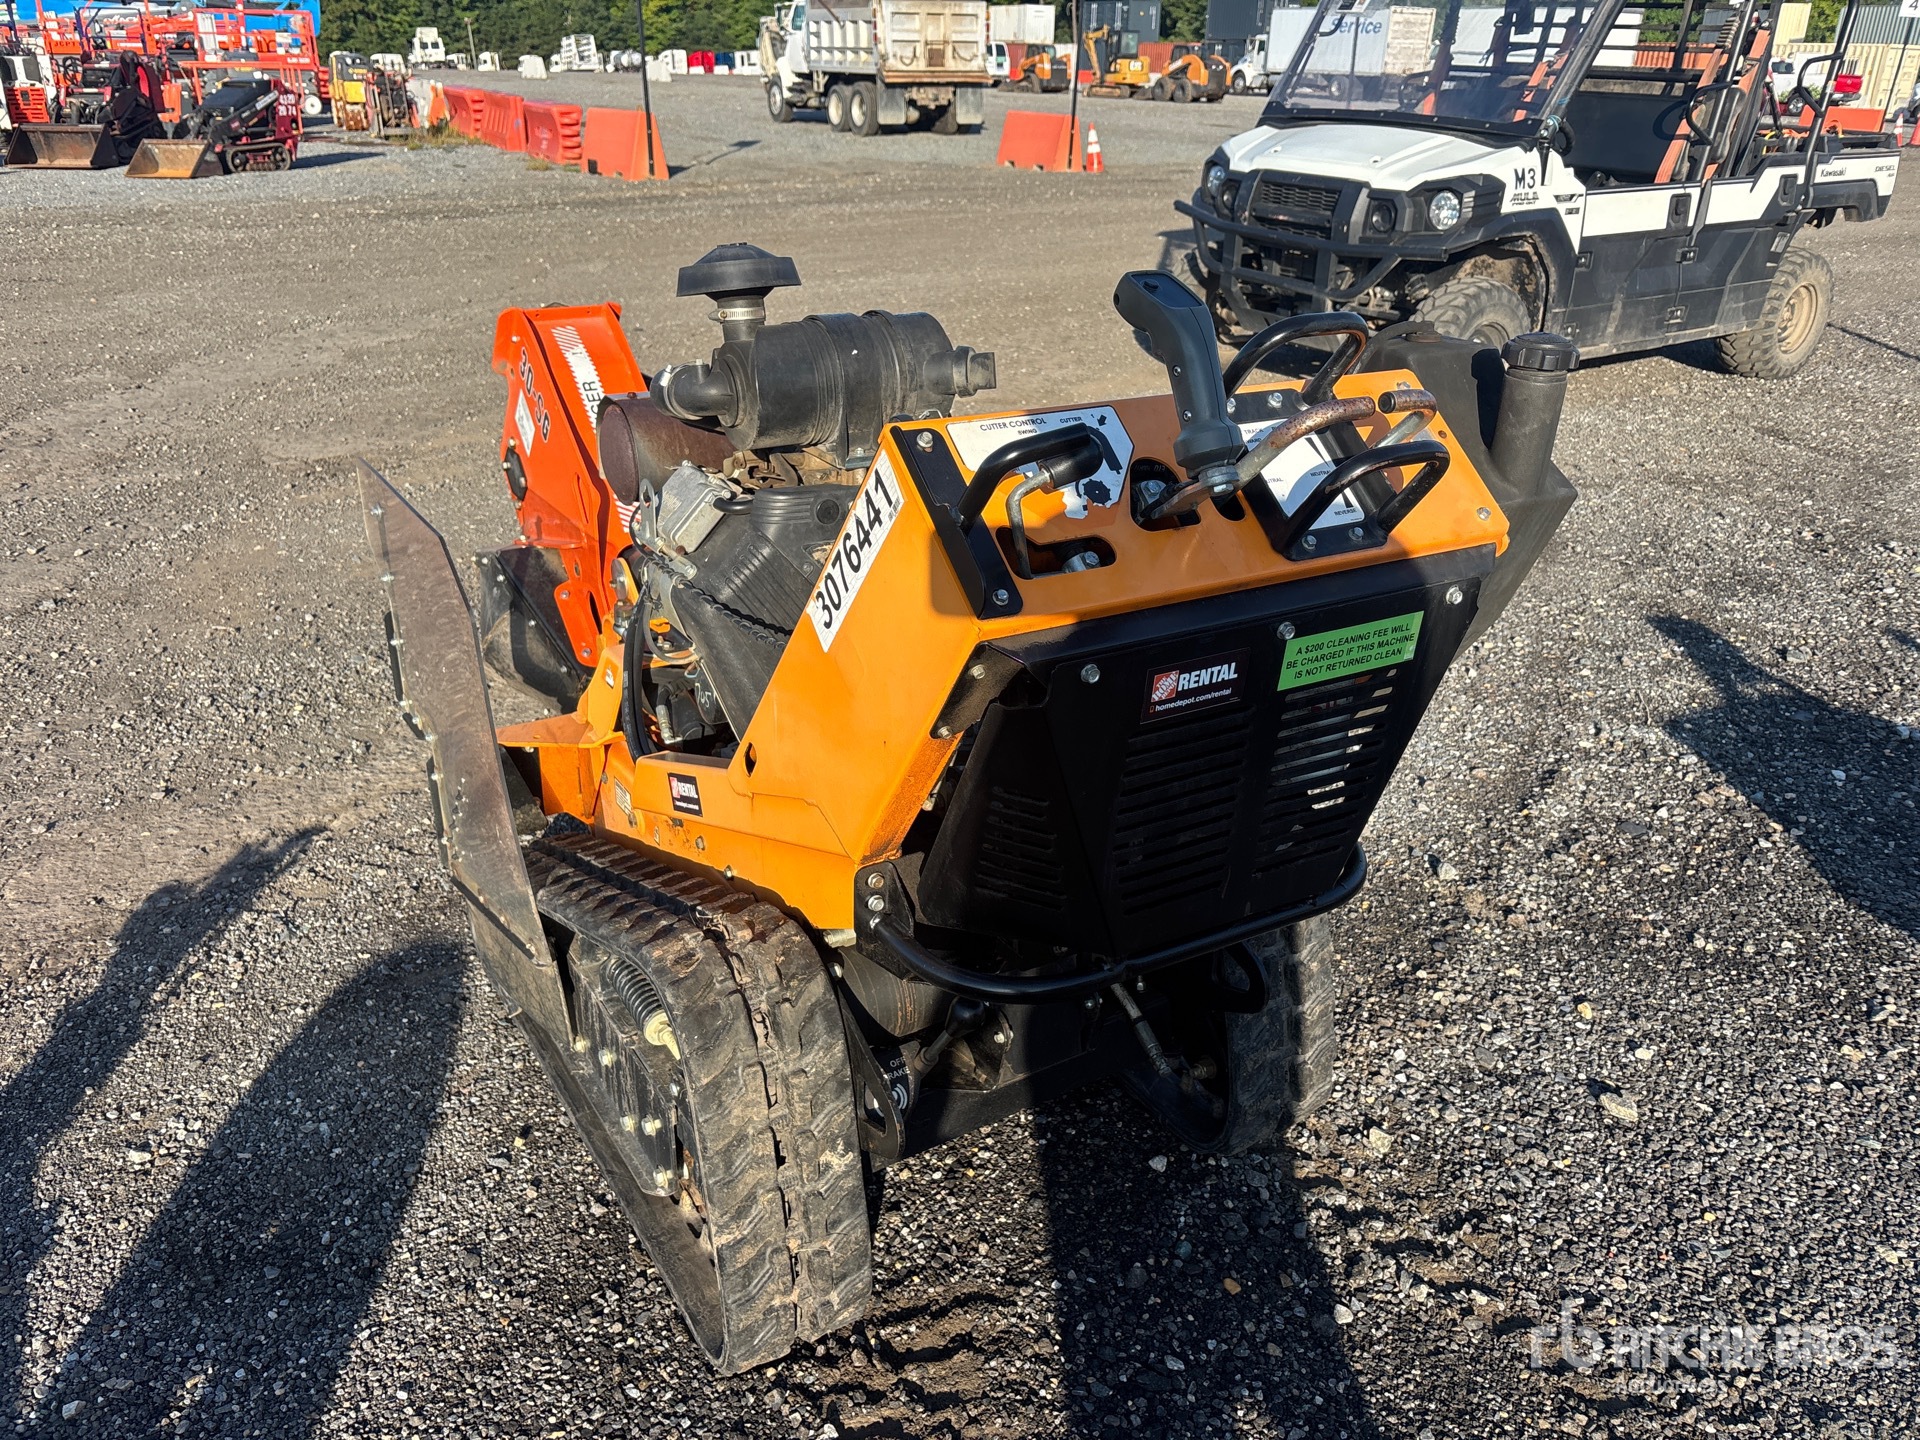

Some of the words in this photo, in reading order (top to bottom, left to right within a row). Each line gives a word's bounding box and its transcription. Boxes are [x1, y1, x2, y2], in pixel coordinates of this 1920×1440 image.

[1513, 168, 1536, 190] M3
[1820, 167, 1847, 177] Kawasaki
[980, 422, 1008, 432] CUTTER
[1009, 417, 1047, 428] CONTROL
[1060, 416, 1082, 424] CUTTER
[1333, 507, 1358, 516] REVERSE
[815, 467, 894, 630] 3076441
[1286, 659, 1298, 670] BE
[1300, 649, 1344, 667] CHARGED
[1346, 647, 1354, 656] IF
[1356, 642, 1375, 654] THIS
[1376, 632, 1416, 649] MACHINE
[1296, 646, 1303, 656] A
[1304, 642, 1325, 653] $200
[1326, 631, 1371, 649] CLEANING
[1372, 627, 1389, 639] FEE
[1390, 623, 1410, 634] WILL
[1294, 670, 1303, 679] IS
[1304, 665, 1325, 677] NOT
[1325, 654, 1372, 672] RETURNED
[1374, 647, 1403, 660] CLEAN
[1151, 671, 1179, 701] HOME
[1177, 662, 1238, 691] RENTAL
[1155, 687, 1232, 712] homedepot.com/rental
[887, 1065, 910, 1079] RAKE
